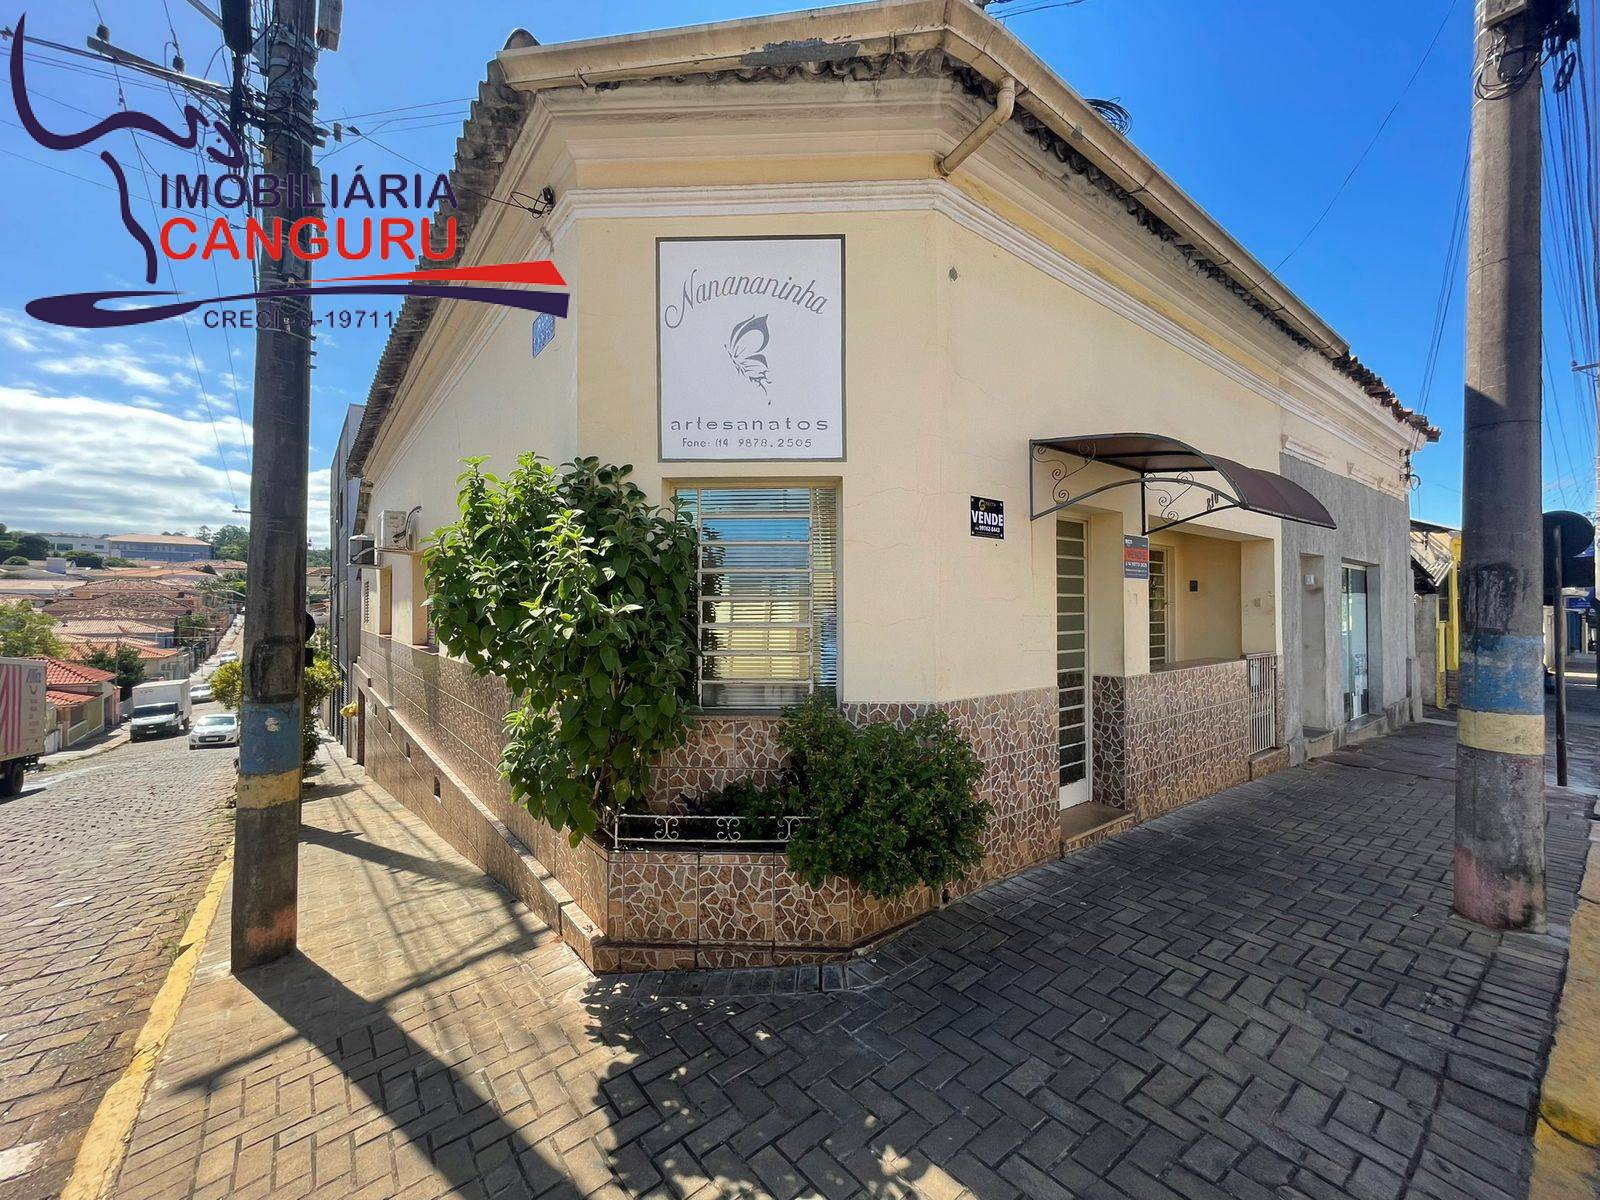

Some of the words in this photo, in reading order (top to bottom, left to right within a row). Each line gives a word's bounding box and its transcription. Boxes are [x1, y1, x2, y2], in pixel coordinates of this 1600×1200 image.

[664, 268, 829, 329] Nanananinha
[670, 416, 829, 431] artesanatos
[738, 438, 813, 448] 9878.2505
[971, 509, 1004, 527] VENDE
